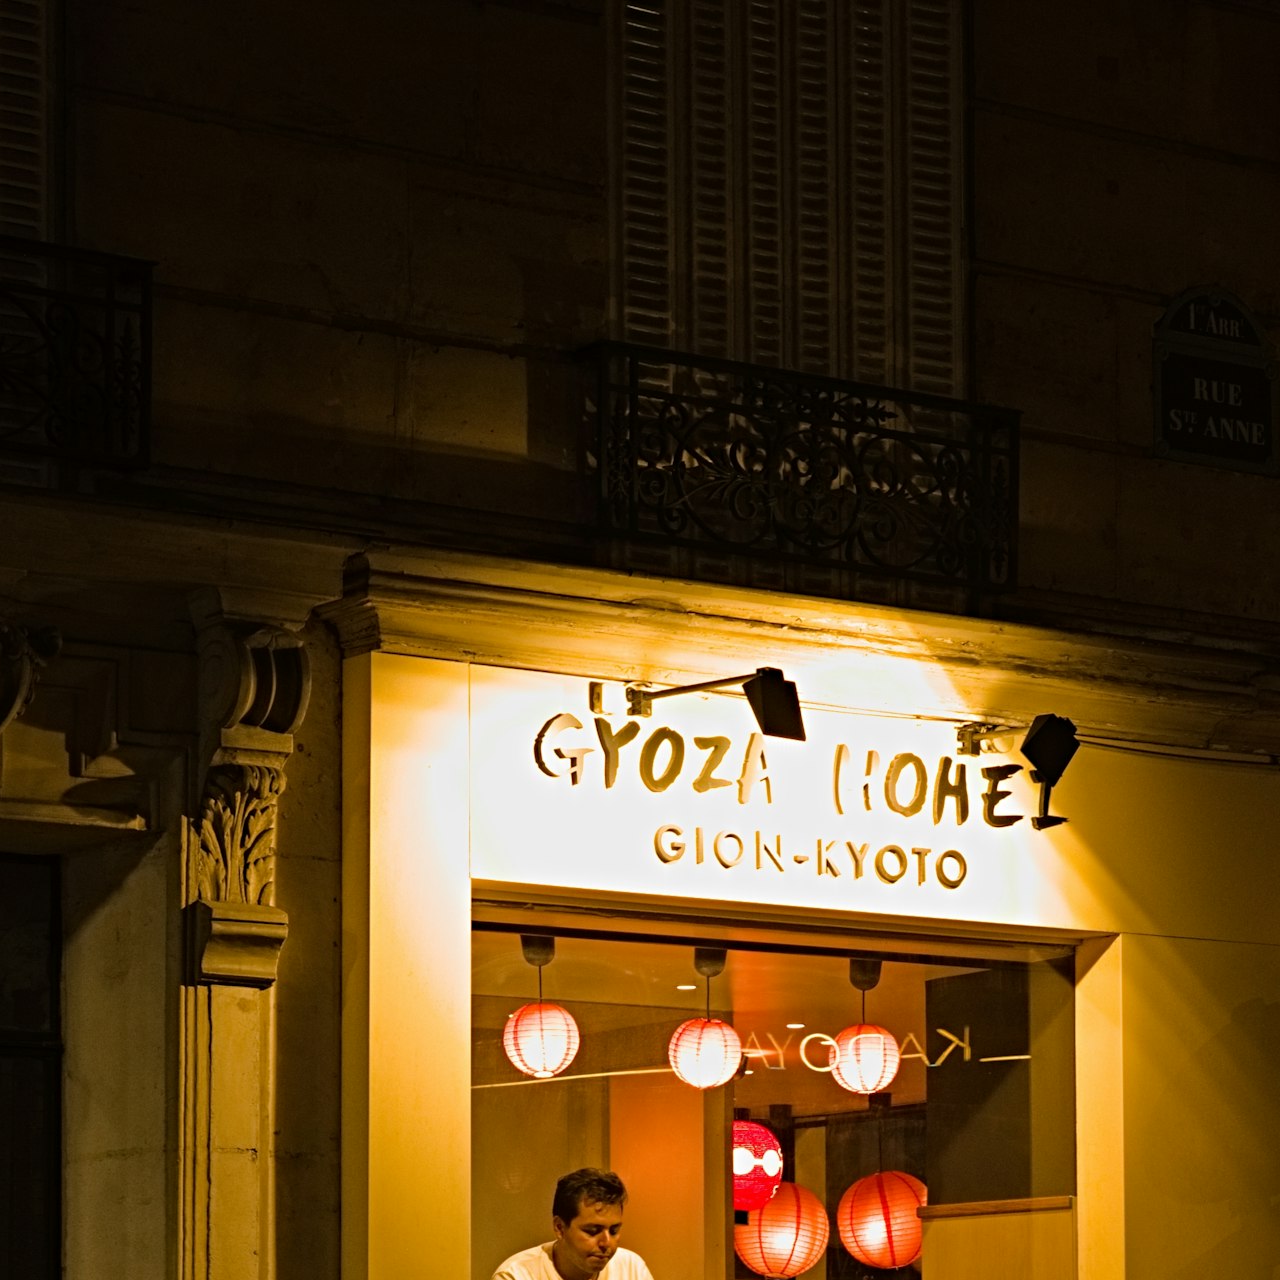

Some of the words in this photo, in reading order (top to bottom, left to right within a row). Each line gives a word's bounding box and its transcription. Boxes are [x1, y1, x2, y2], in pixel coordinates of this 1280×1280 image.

[1193, 377, 1243, 407] RUE
[1202, 415, 1266, 446] ANNE
[533, 712, 773, 805] GYOZA
[653, 824, 969, 891] GION-KYOTO
